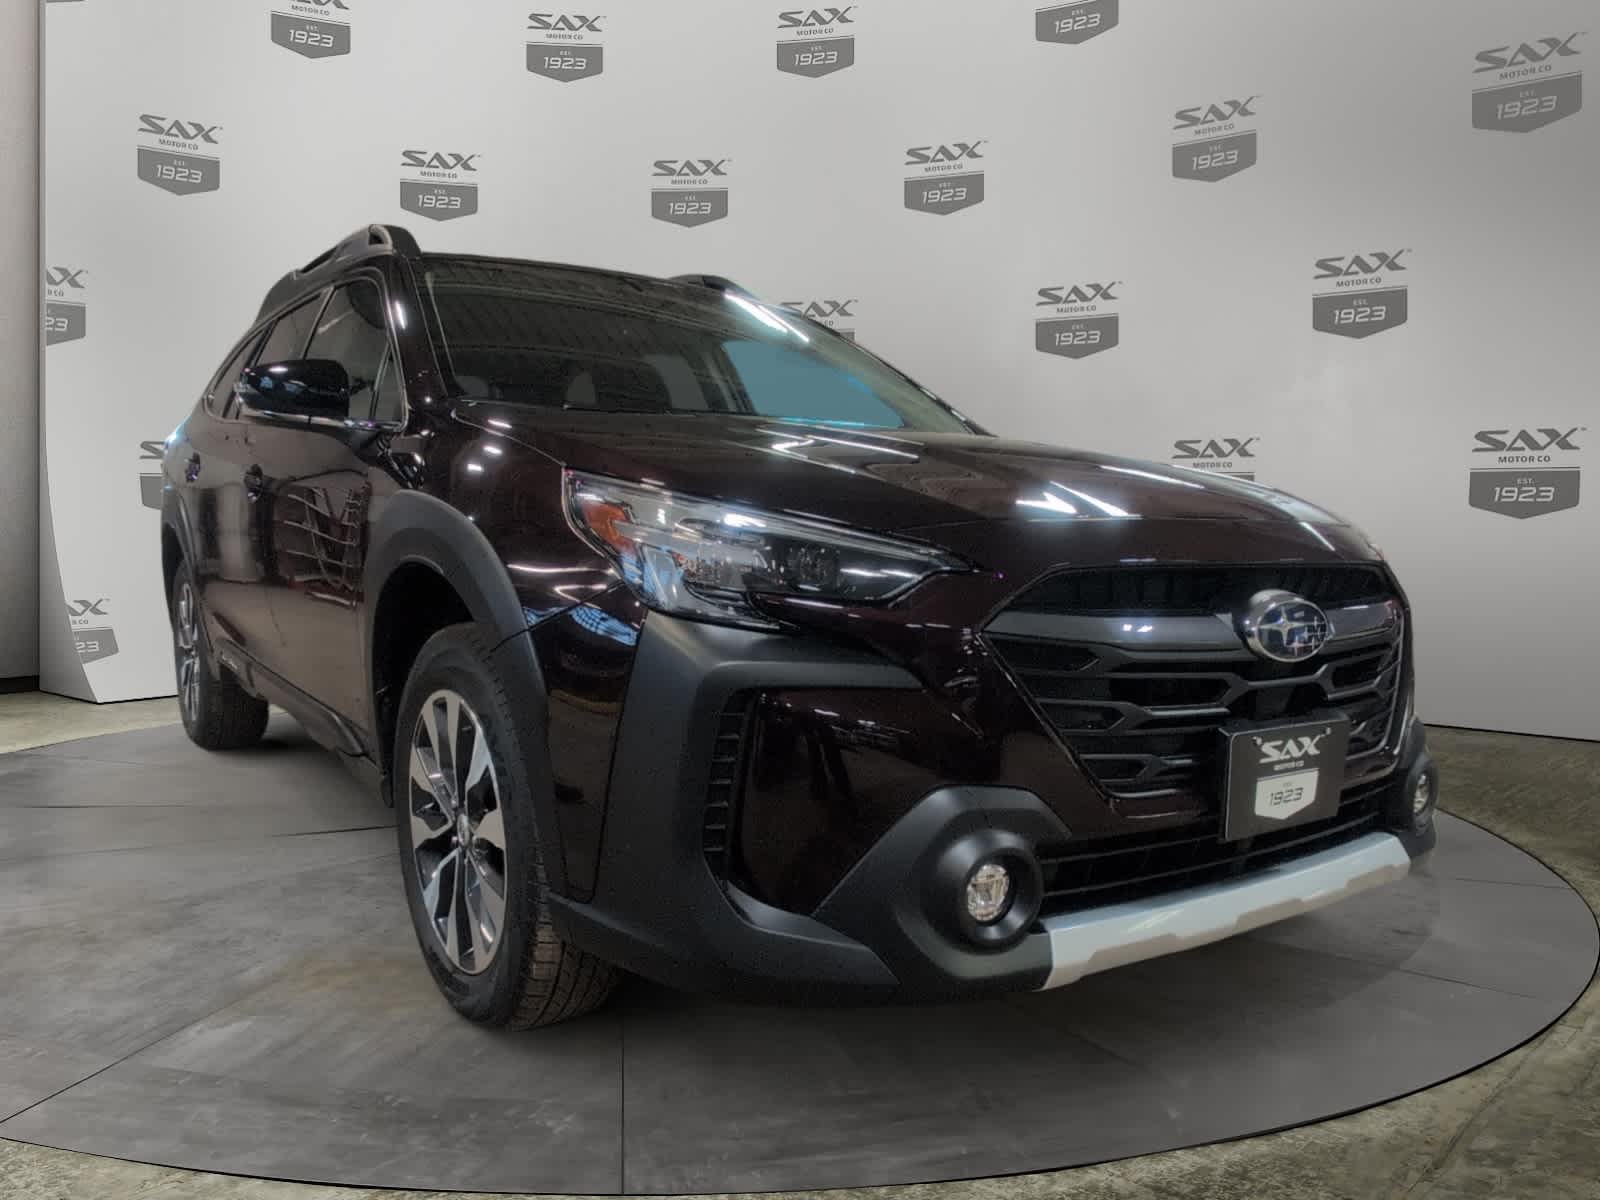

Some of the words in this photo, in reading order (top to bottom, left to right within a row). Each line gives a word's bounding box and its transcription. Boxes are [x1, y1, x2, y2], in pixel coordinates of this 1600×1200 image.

[527, 13, 603, 33] SAX
[777, 6, 855, 29] SAX
[1054, 13, 1101, 34] 1923
[289, 29, 334, 48] 1923
[794, 51, 838, 66] 1923
[1472, 32, 1583, 73] SAX
[543, 56, 587, 70] 1923
[1499, 66, 1536, 80] MOTOR
[1537, 64, 1553, 73] CO
[1173, 95, 1257, 130] SAX
[1496, 95, 1558, 120] 1923
[137, 114, 219, 145] SAX
[400, 150, 478, 171] SAX
[904, 140, 984, 165] SAX
[1192, 150, 1239, 171] 1923
[156, 164, 203, 184] 1923
[651, 159, 728, 177] SAX
[417, 194, 462, 208] 1923
[922, 188, 968, 205] 1923
[669, 202, 712, 215] 1923
[1313, 249, 1407, 280] SAX
[1335, 279, 1368, 288] MOTOR
[1369, 276, 1382, 284] CO
[1035, 281, 1119, 306] SAX
[1056, 306, 1085, 314] MOTOR
[1333, 305, 1387, 325] 1923
[1055, 330, 1101, 346] 1923
[1172, 437, 1255, 459] SAX
[1472, 427, 1581, 453] SAX
[1192, 461, 1221, 469] MOTOR
[1498, 455, 1536, 464] MOTOR
[1537, 454, 1551, 463] CO
[1494, 486, 1556, 502] 1923
[74, 640, 100, 653] 23
[1259, 735, 1321, 764] SAX
[1270, 787, 1305, 806] 1923
